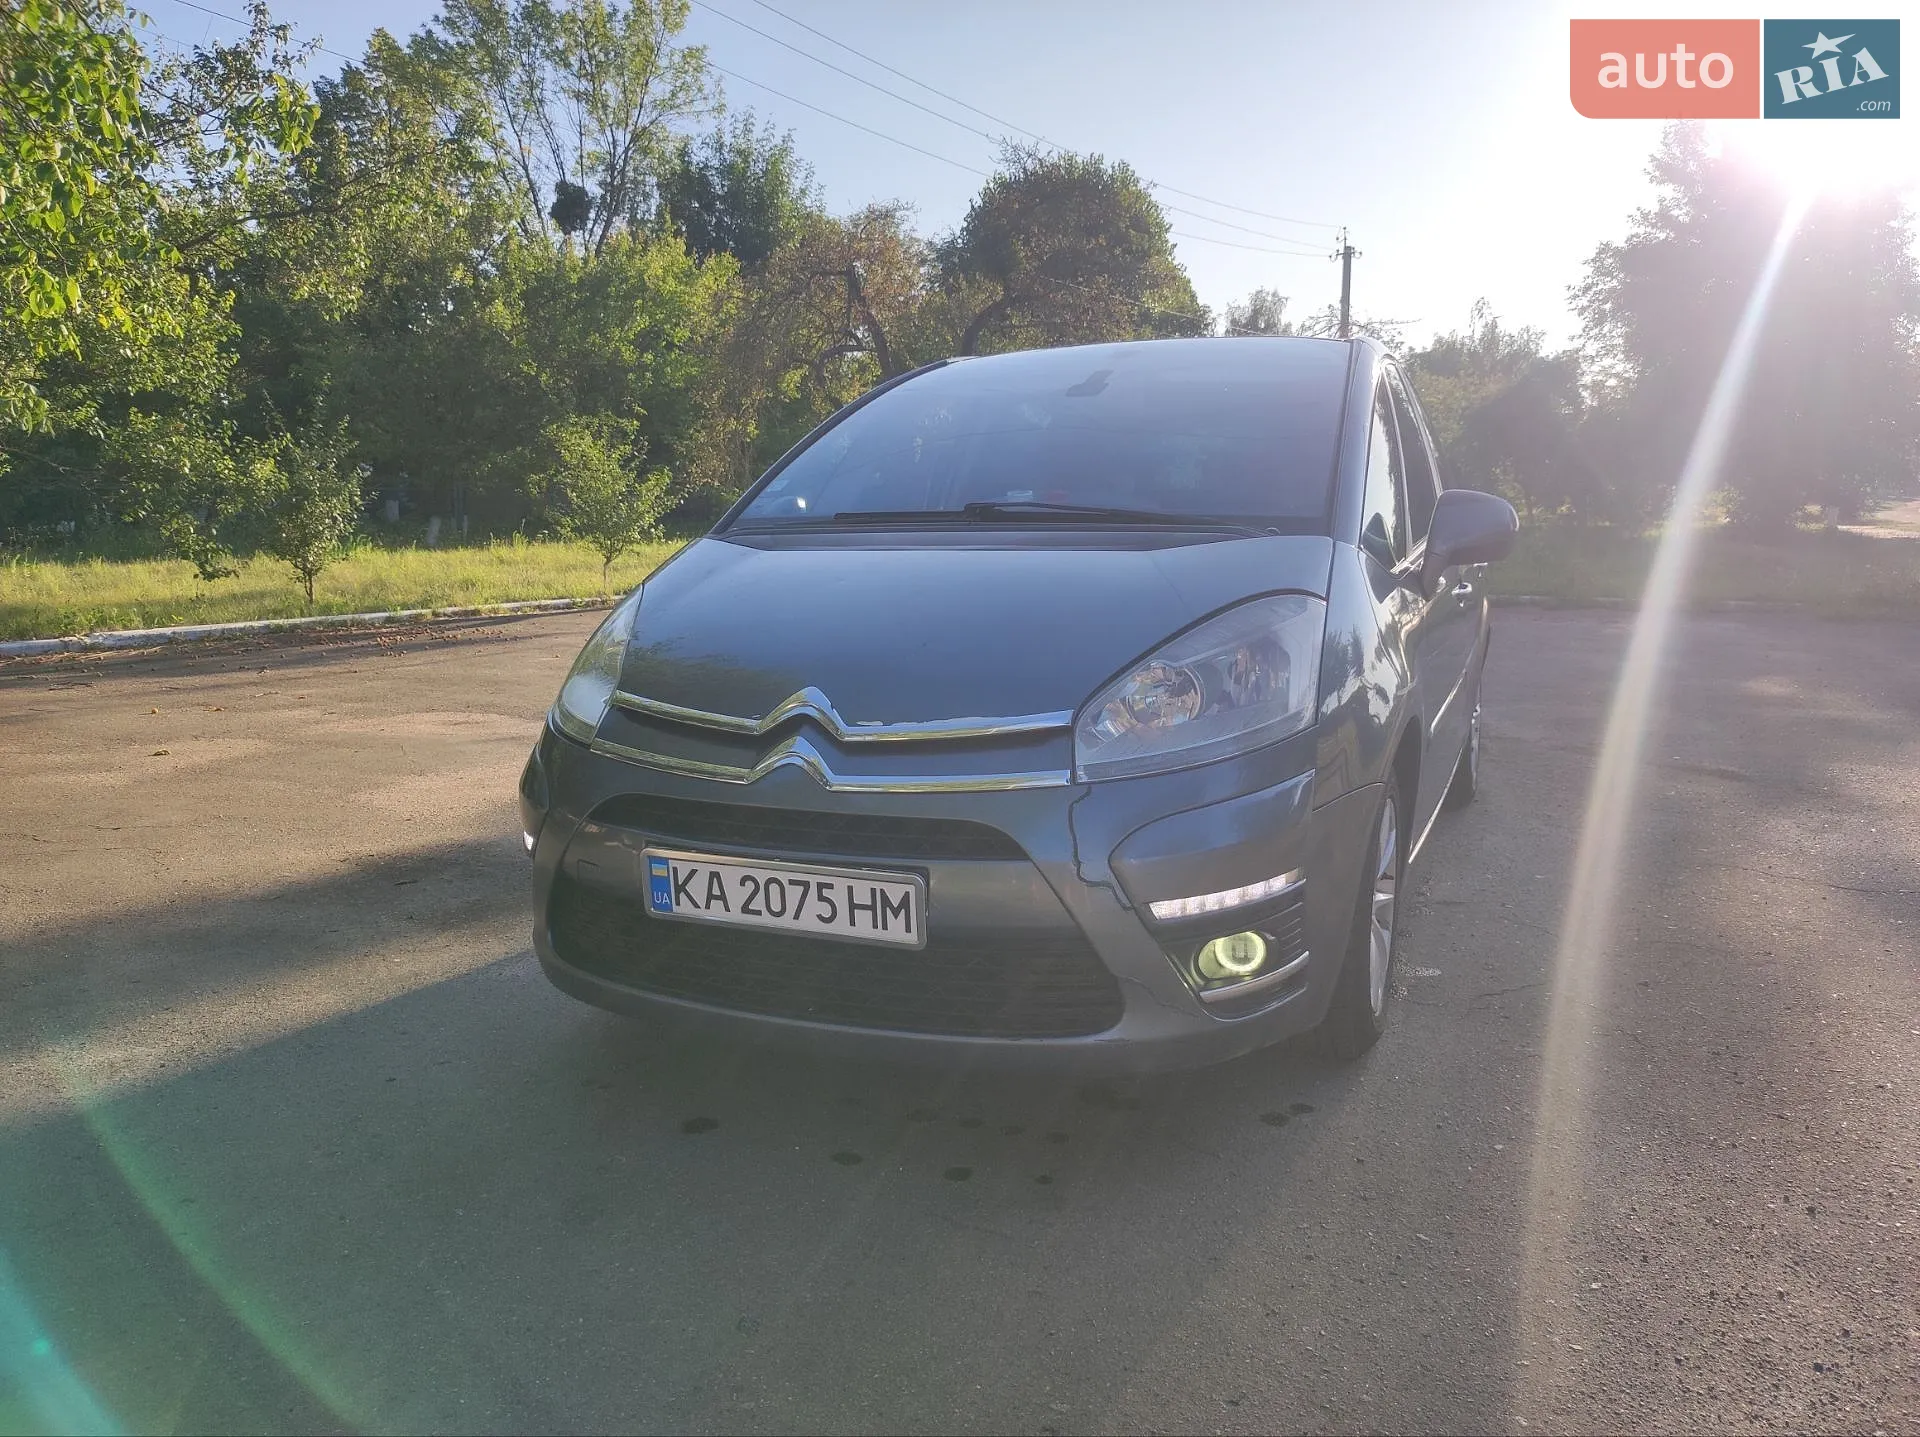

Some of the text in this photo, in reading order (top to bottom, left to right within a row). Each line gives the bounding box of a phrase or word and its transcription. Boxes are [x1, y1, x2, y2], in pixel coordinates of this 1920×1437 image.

[654, 891, 671, 905] UA
[671, 866, 912, 934] KA 2075 HM
